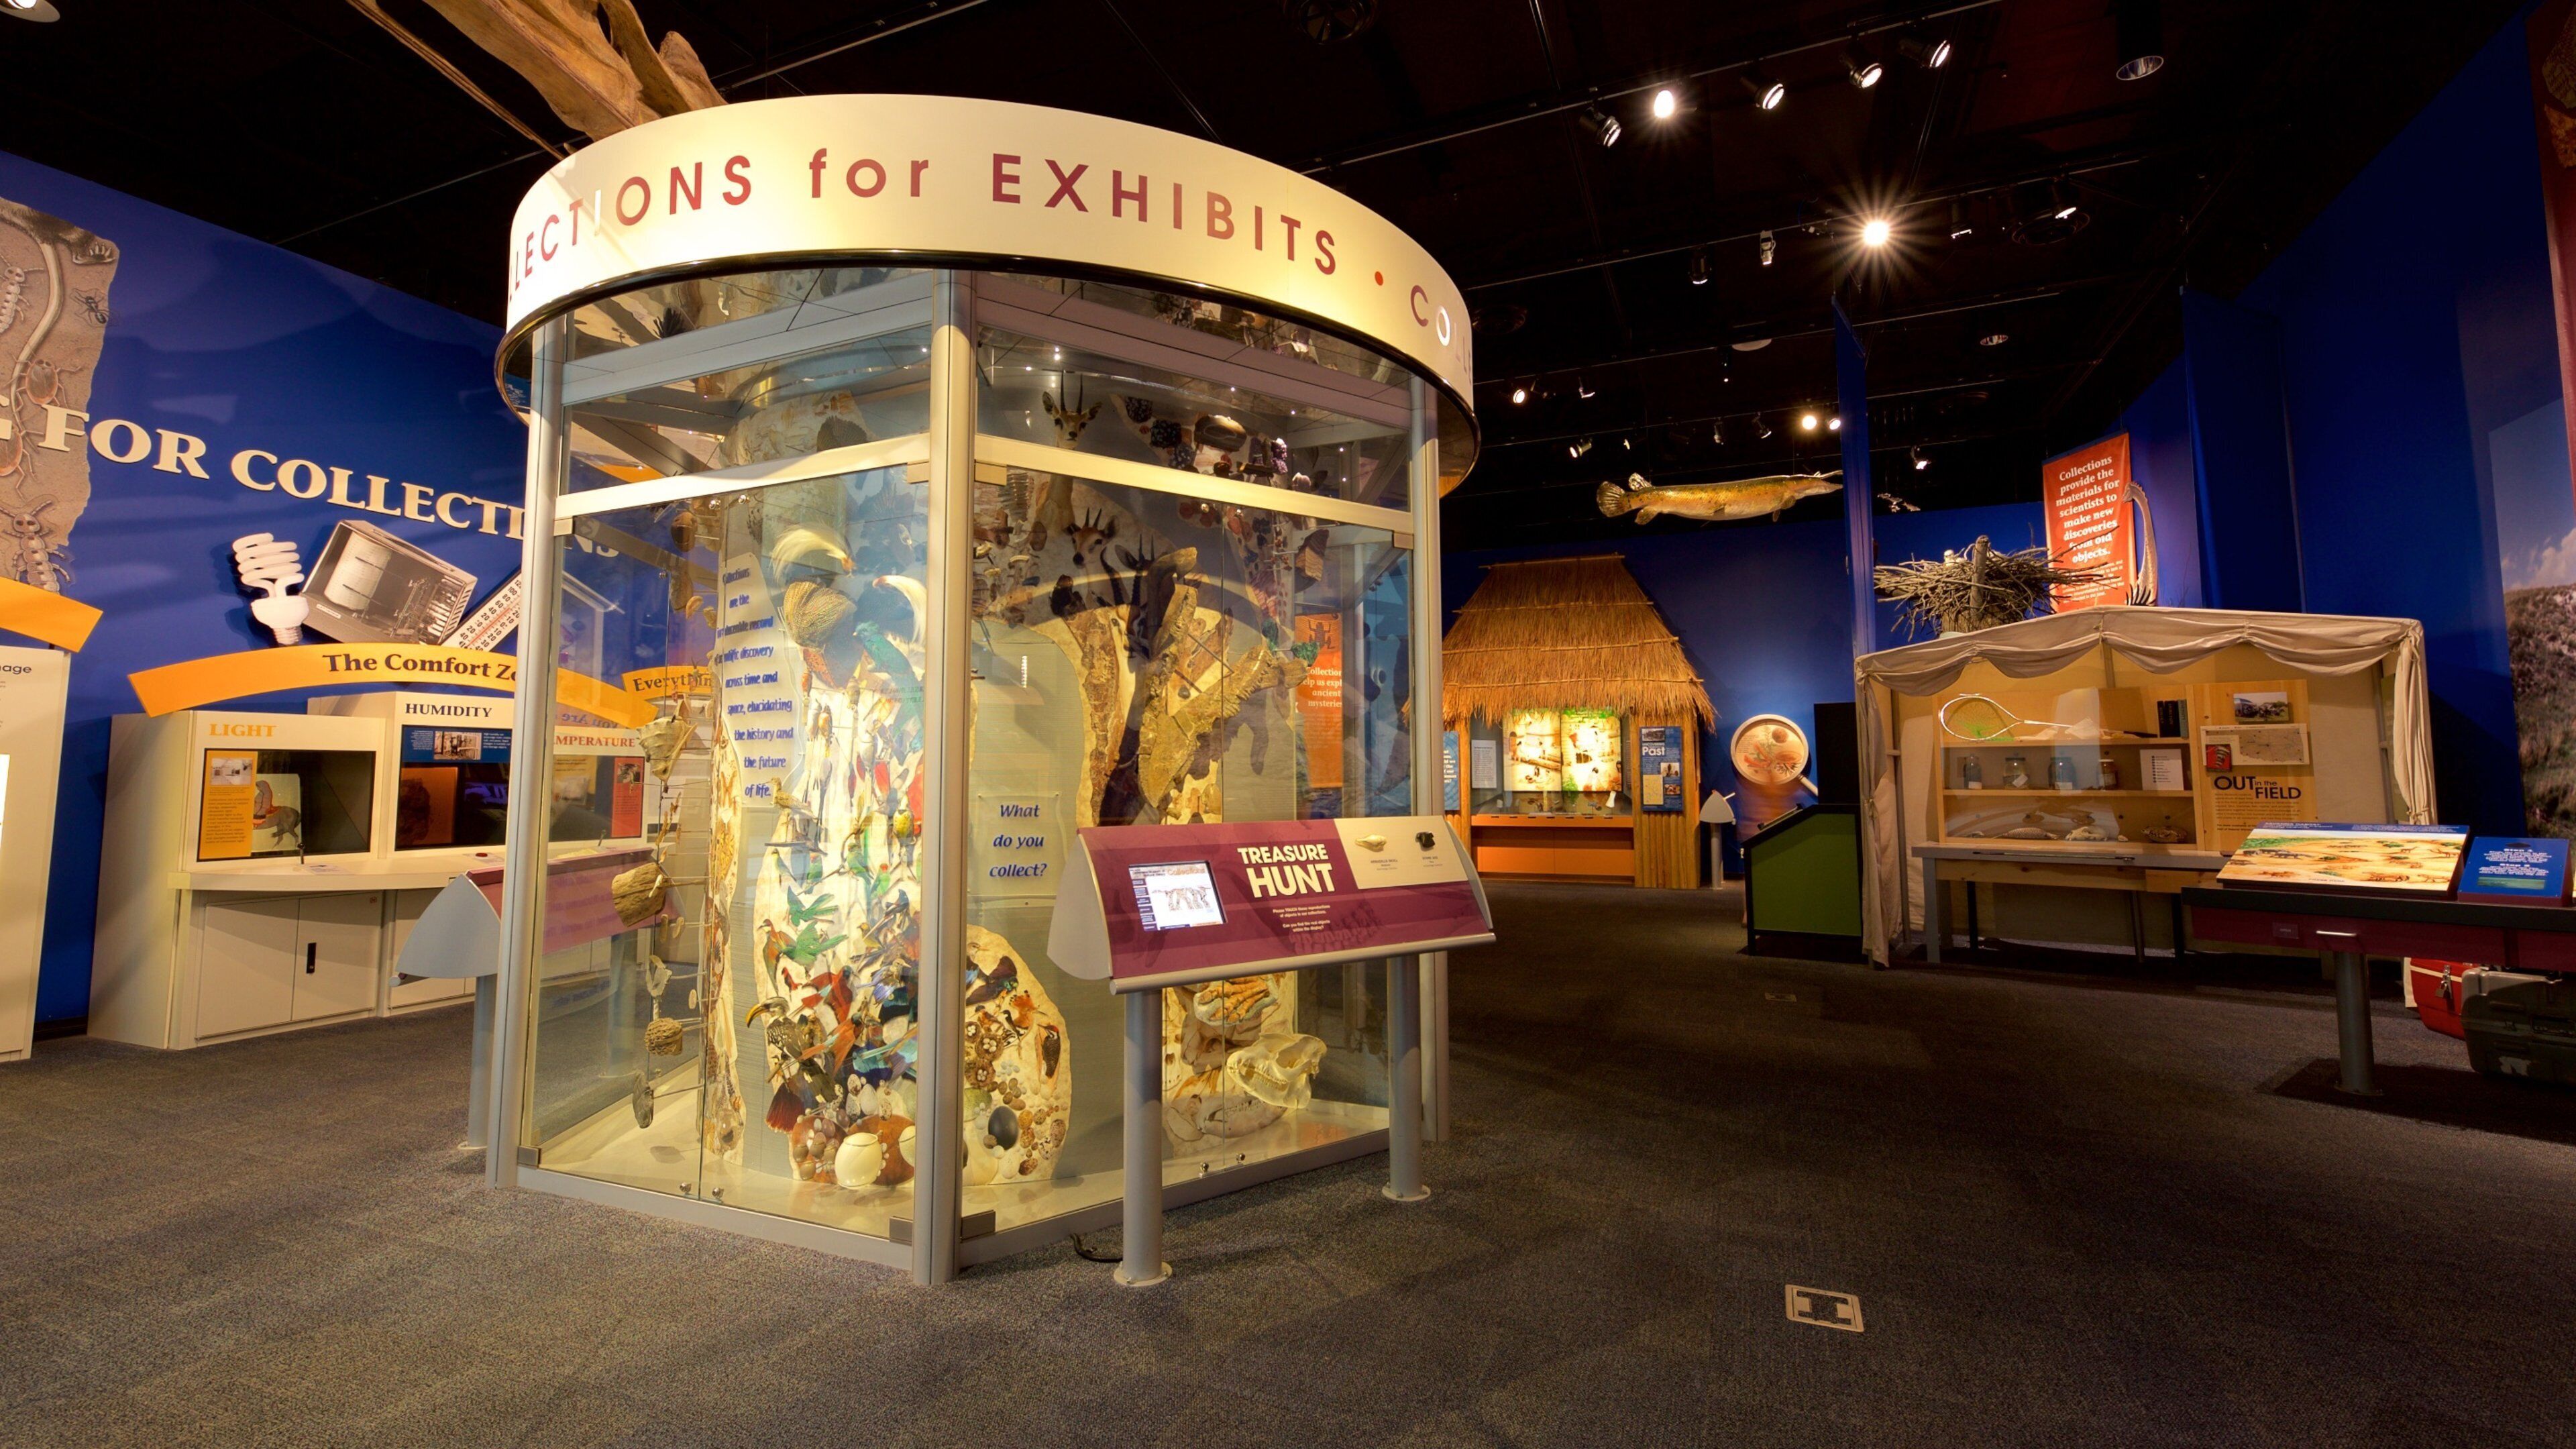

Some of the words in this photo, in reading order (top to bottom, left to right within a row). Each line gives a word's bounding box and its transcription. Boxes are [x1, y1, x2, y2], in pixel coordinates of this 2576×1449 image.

[809, 148, 928, 199] for
[992, 154, 1336, 275] EXHIBITS
[38, 404, 209, 480] FOR
[2059, 456, 2112, 481] Collections
[2060, 475, 2095, 496] provide
[2097, 469, 2114, 480] the
[2055, 485, 2102, 506] materials
[2104, 479, 2120, 490] for
[2059, 497, 2104, 518] scientists
[2106, 494, 2117, 502] to
[2063, 515, 2092, 529] make
[2093, 507, 2114, 520] new
[2063, 519, 2118, 541] discoveries
[2094, 532, 2112, 545] old
[2072, 547, 2111, 563] objects.
[502, 594, 511, 602] 80
[508, 586, 517, 596] 100
[495, 600, 504, 608] 60
[739, 594, 749, 606] the
[481, 613, 490, 621] 20
[488, 606, 497, 614] 40
[467, 625, 476, 634] 20
[749, 616, 773, 631] record
[460, 632, 468, 640] 40
[487, 633, 496, 641] 20
[494, 628, 502, 636] 10
[480, 639, 490, 647] 30
[740, 646, 773, 659] discovery
[323, 653, 377, 672] The
[384, 653, 491, 677] Comfort
[725, 677, 743, 688] across
[744, 673, 761, 686] time
[762, 671, 778, 683] and
[1303, 678, 1315, 688] elp
[1326, 679, 1342, 688] expl
[1312, 689, 1342, 697] ancient
[405, 703, 492, 717] HUMIDITY
[727, 704, 745, 716] space,
[747, 698, 792, 712] elucidating
[209, 723, 276, 737] LIGHT
[735, 730, 745, 741] the
[747, 728, 775, 741] history
[776, 727, 794, 739] and
[554, 735, 636, 747] MPERATURE
[1642, 746, 1665, 756] Past
[744, 757, 757, 768] the
[759, 755, 786, 769] future
[2214, 776, 2255, 790] OUT
[745, 784, 755, 798] of
[755, 784, 771, 798] life.
[2255, 787, 2302, 799] FIELD
[1000, 804, 1040, 817] What
[993, 835, 1012, 847] do
[1016, 837, 1044, 849] you
[1237, 843, 1329, 864] TREASURE
[989, 863, 1047, 877] collect?
[1246, 863, 1335, 898] HUNT
